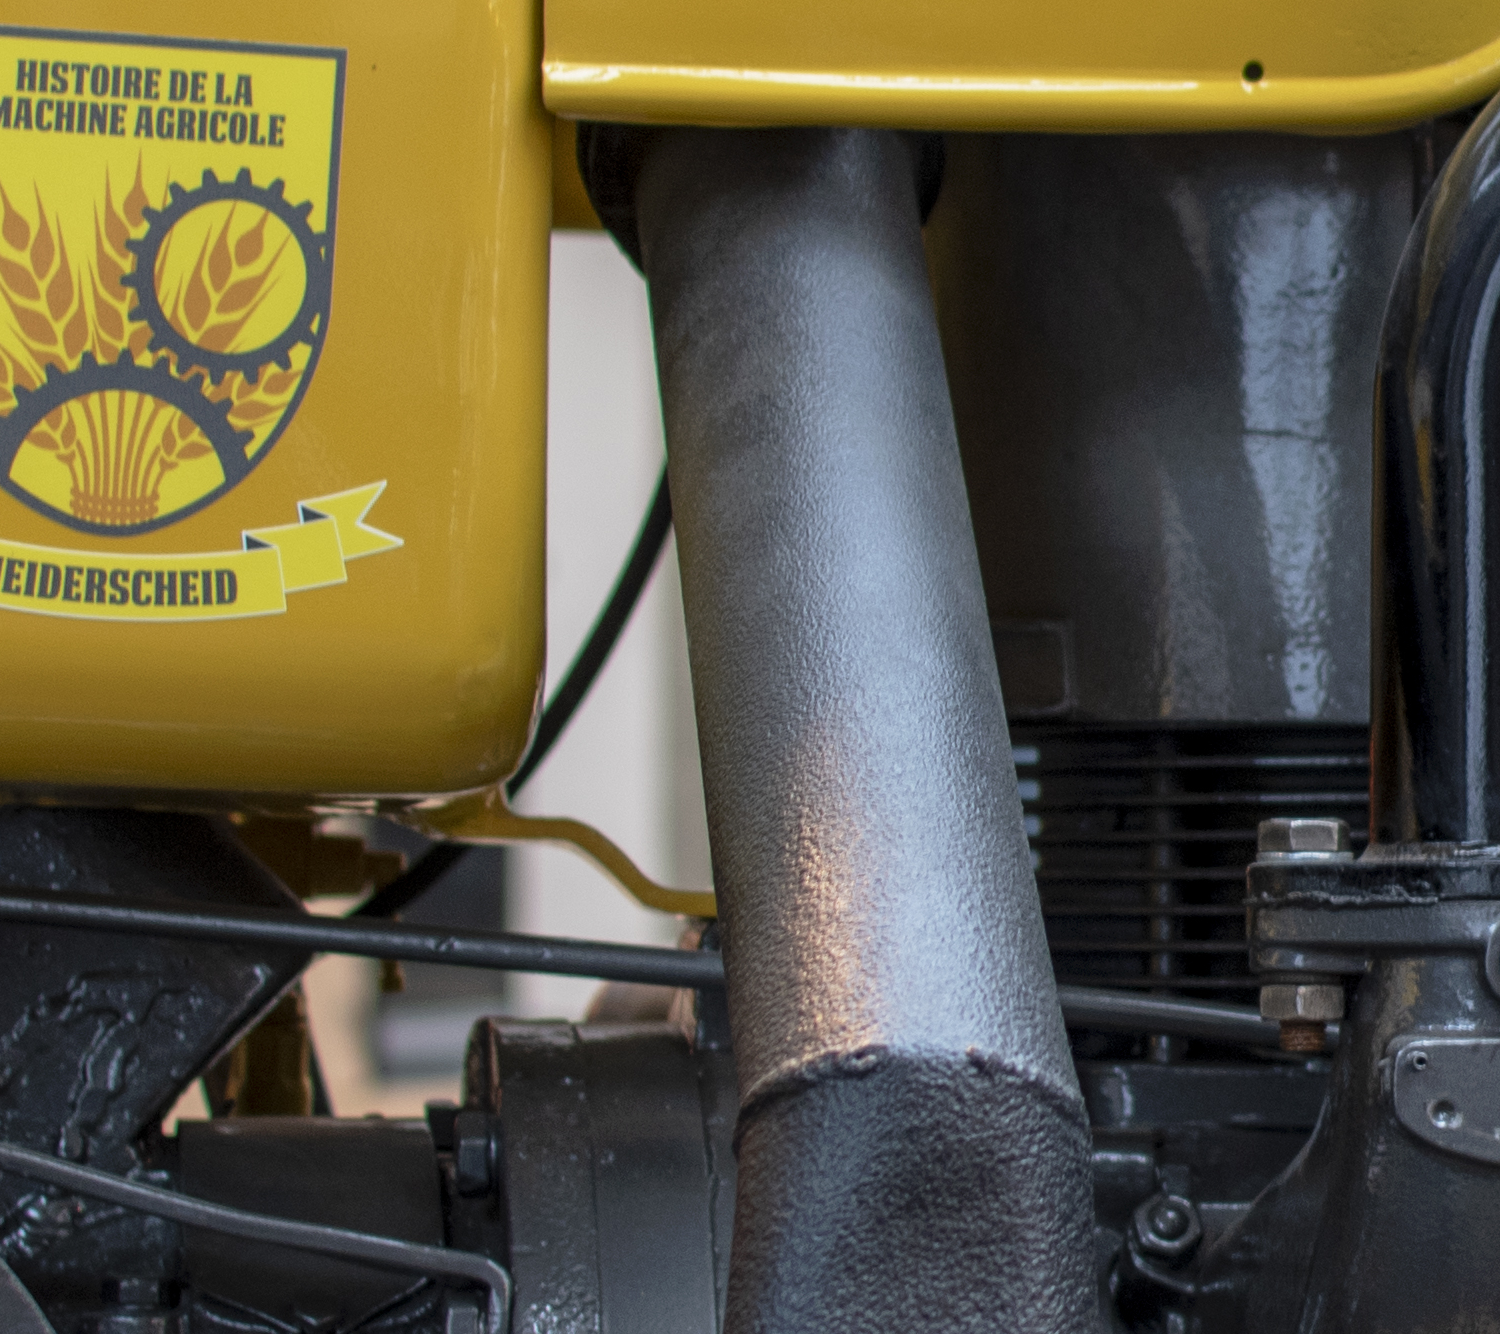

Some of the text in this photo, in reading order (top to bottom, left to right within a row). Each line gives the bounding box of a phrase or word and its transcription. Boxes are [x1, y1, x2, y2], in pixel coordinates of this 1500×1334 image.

[15, 58, 253, 108] HISTOIRE DE LA
[133, 105, 287, 148] AGRICOLE
